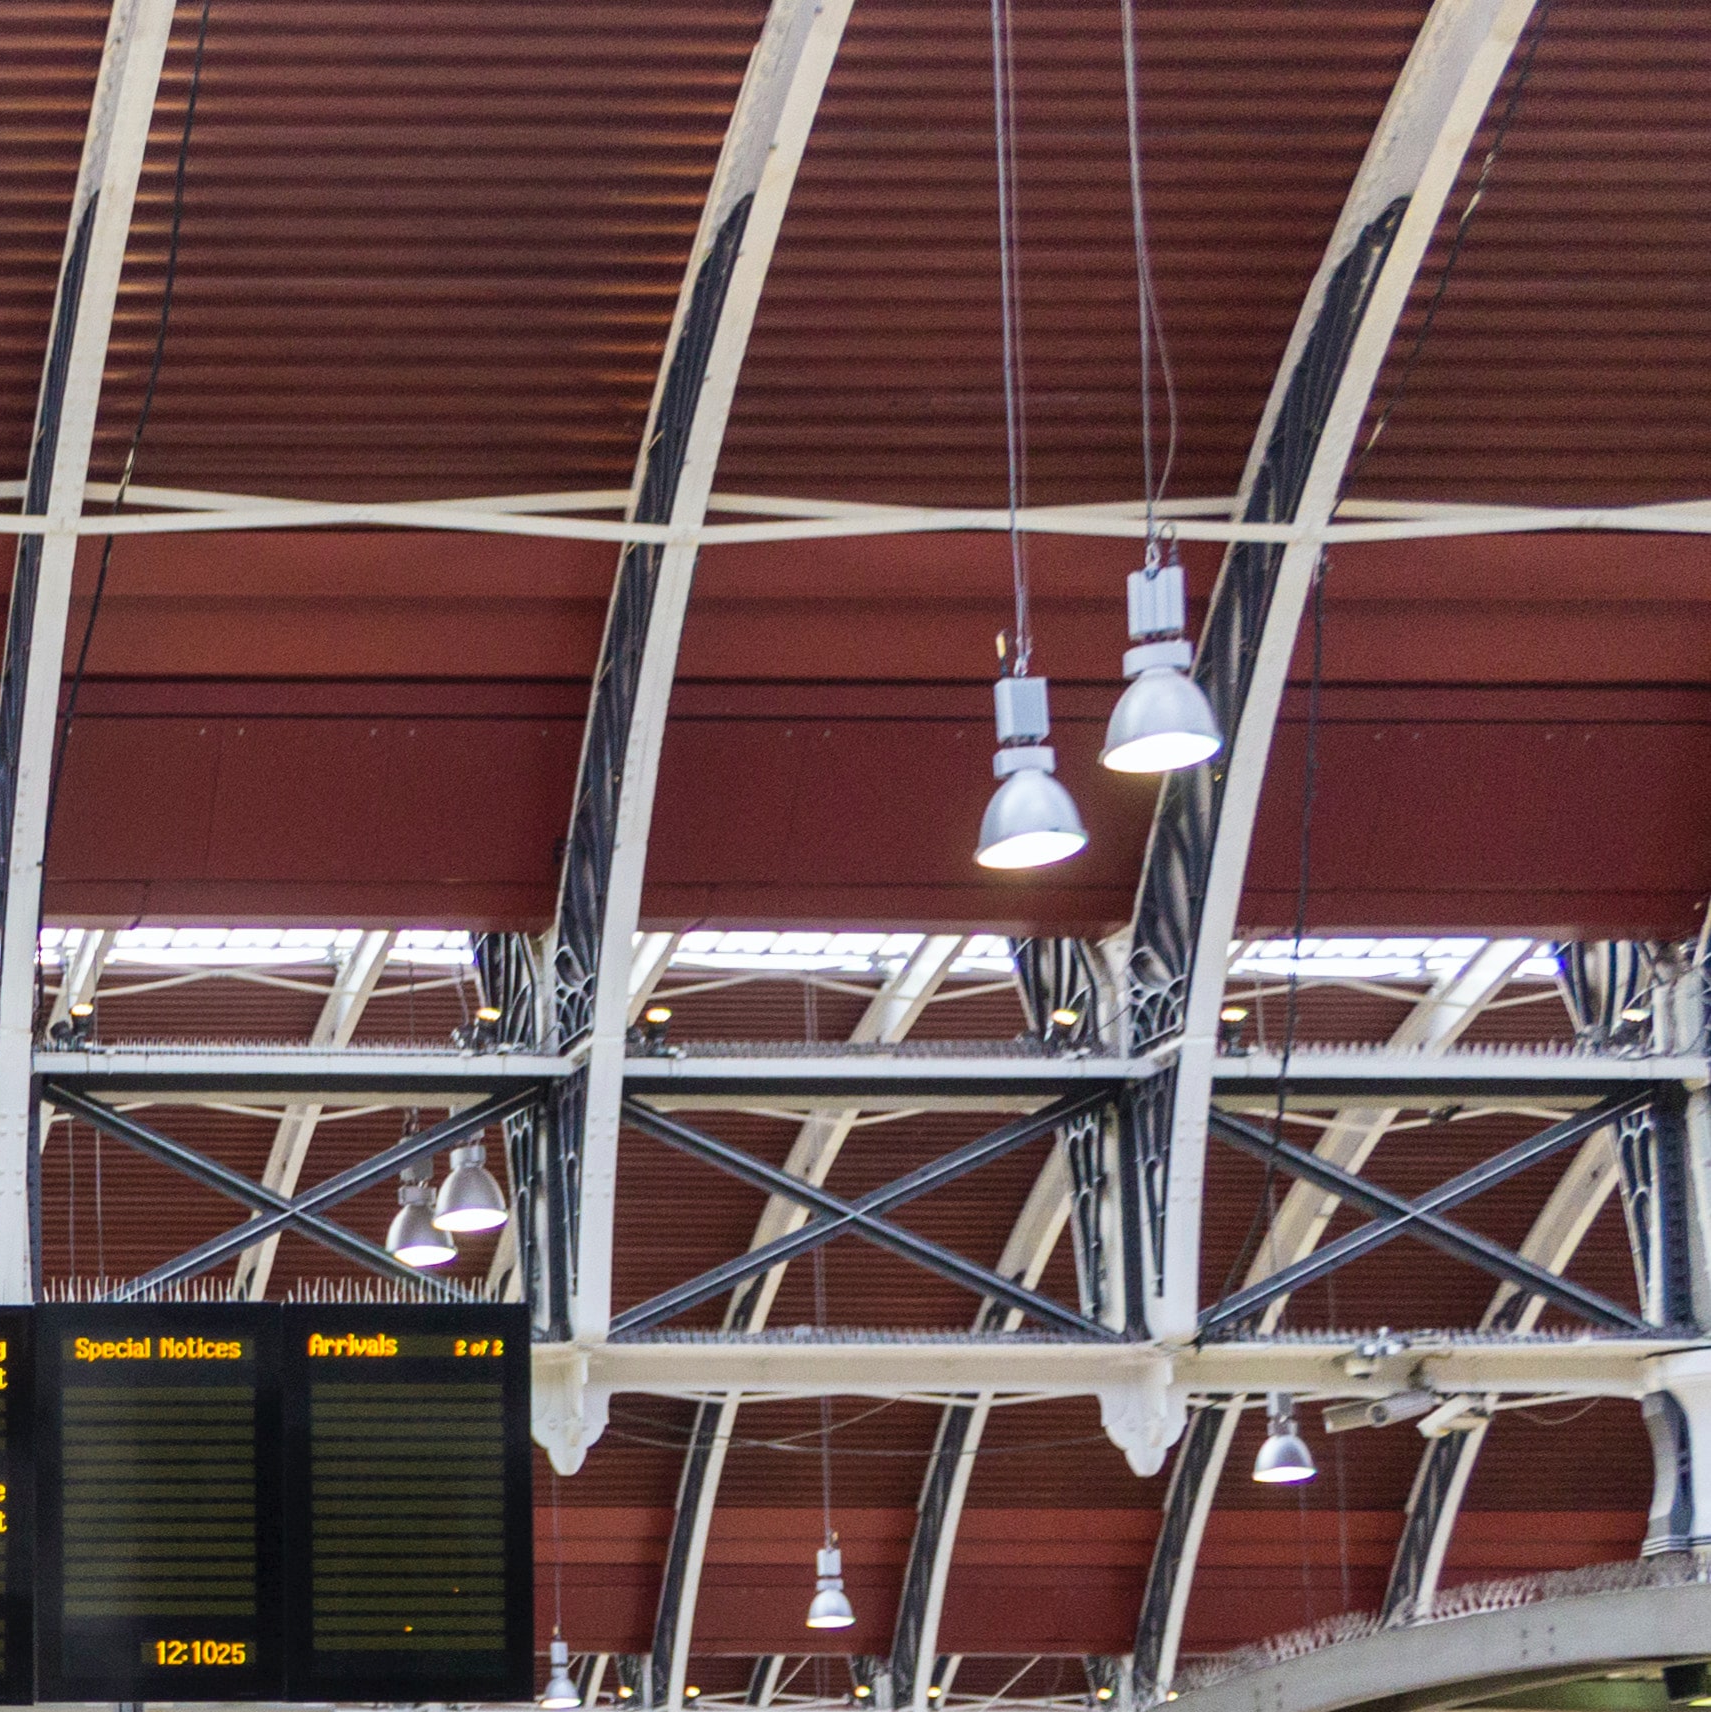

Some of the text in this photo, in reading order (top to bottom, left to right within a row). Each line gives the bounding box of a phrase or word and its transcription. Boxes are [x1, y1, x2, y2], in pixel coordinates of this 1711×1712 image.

[75, 1337, 241, 1361] Special Notices
[308, 1334, 503, 1356] Arrivals 2 of 2
